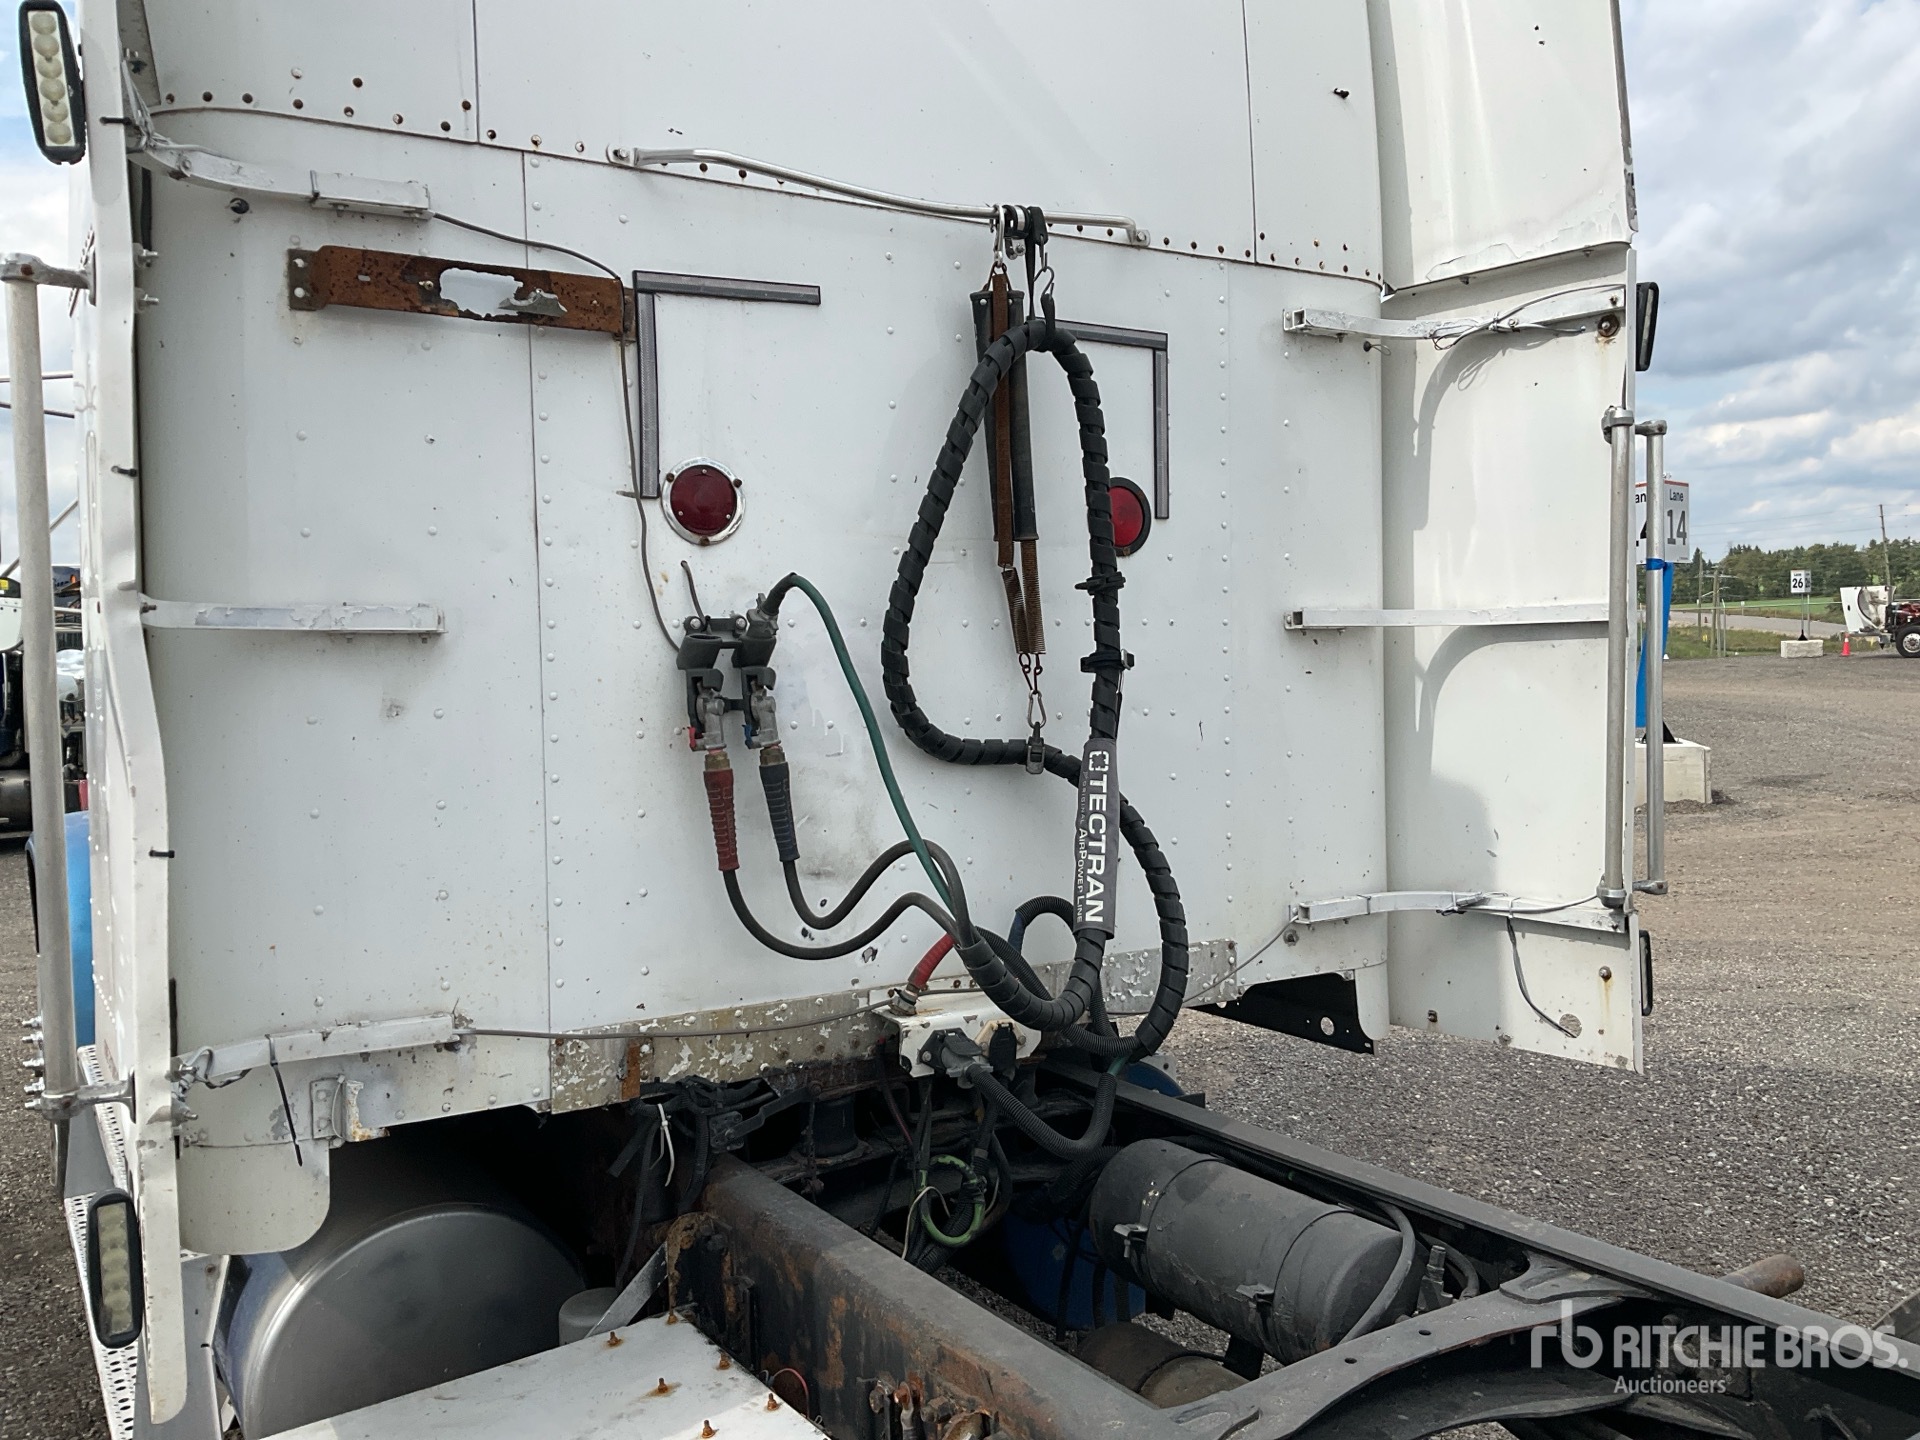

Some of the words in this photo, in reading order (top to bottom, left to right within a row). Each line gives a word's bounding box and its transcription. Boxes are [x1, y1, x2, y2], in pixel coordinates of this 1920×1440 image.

[1669, 489, 1683, 502] Lane
[1667, 510, 1687, 545] 14
[1792, 577, 1803, 588] 26
[1085, 774, 1108, 922] TECTRAN
